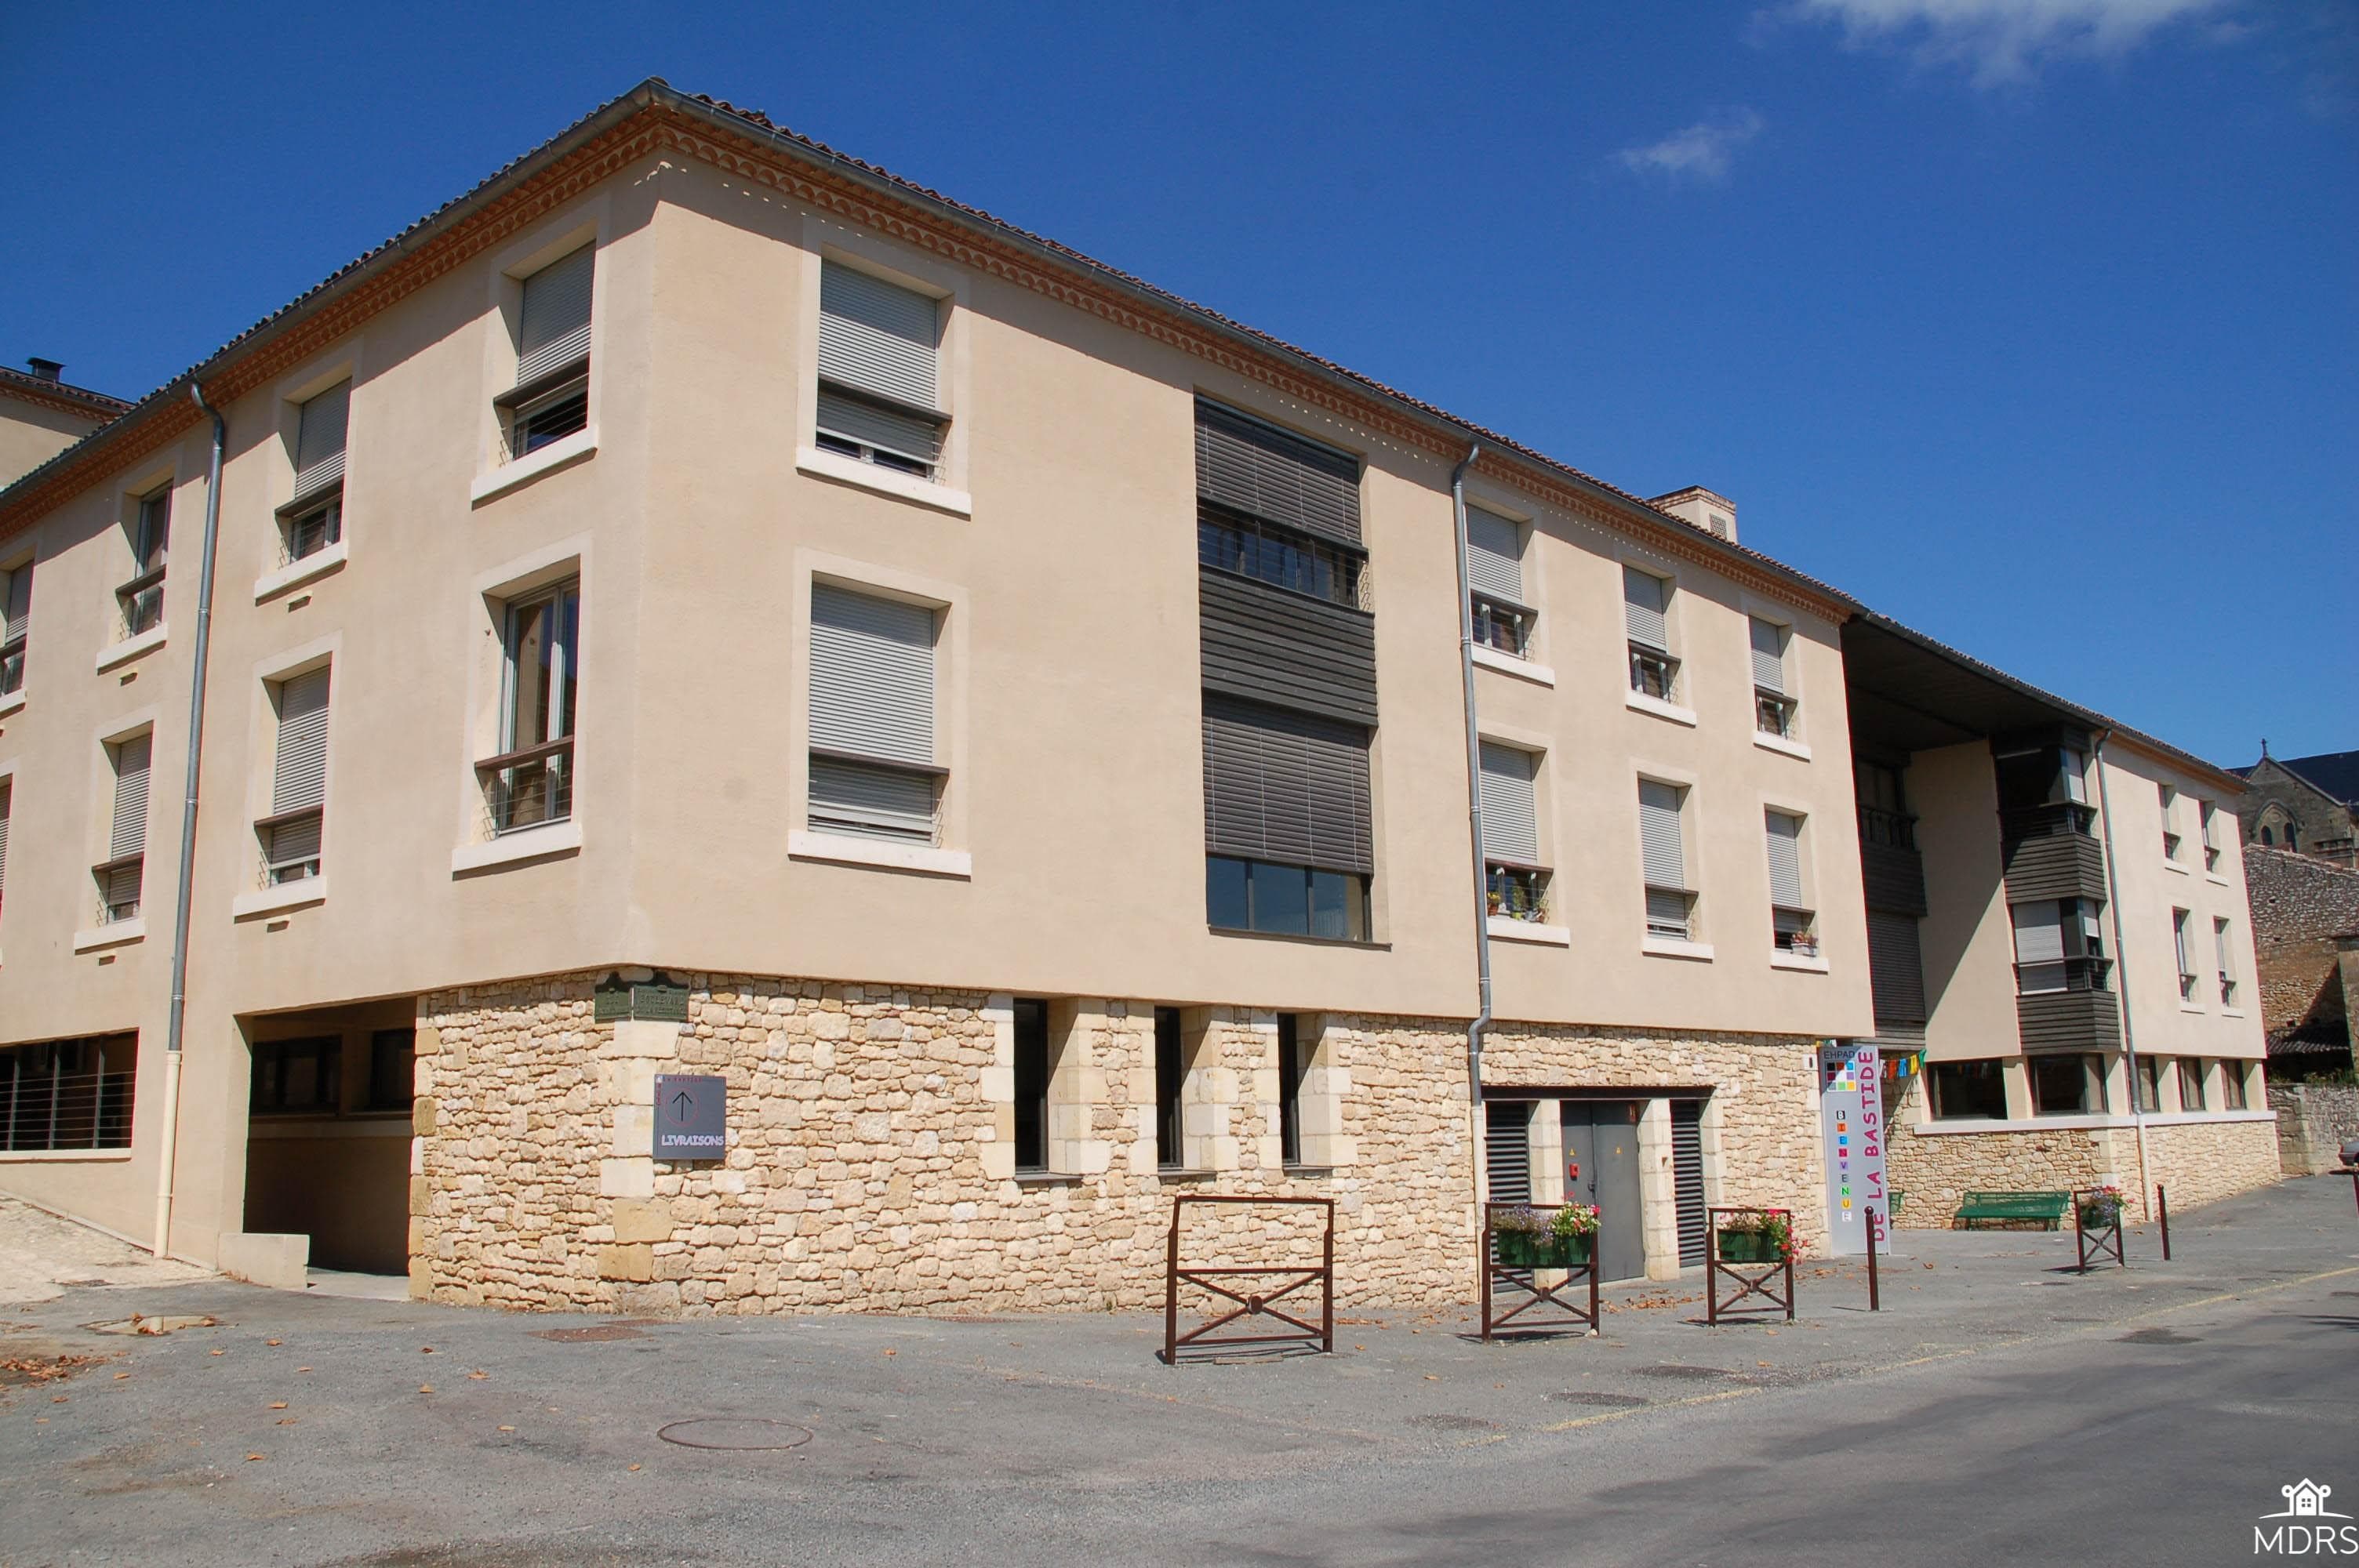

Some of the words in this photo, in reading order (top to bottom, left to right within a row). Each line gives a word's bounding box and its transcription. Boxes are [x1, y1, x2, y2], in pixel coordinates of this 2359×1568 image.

[1823, 1051, 1856, 1059] EHPAD
[1858, 1051, 1879, 1156] BASTIDE
[661, 1134, 724, 1146] LIVRAISONS
[1837, 1111, 1852, 1221] BIENVENUE
[1866, 1171, 1882, 1199] LA
[1873, 1214, 1885, 1242] DE
